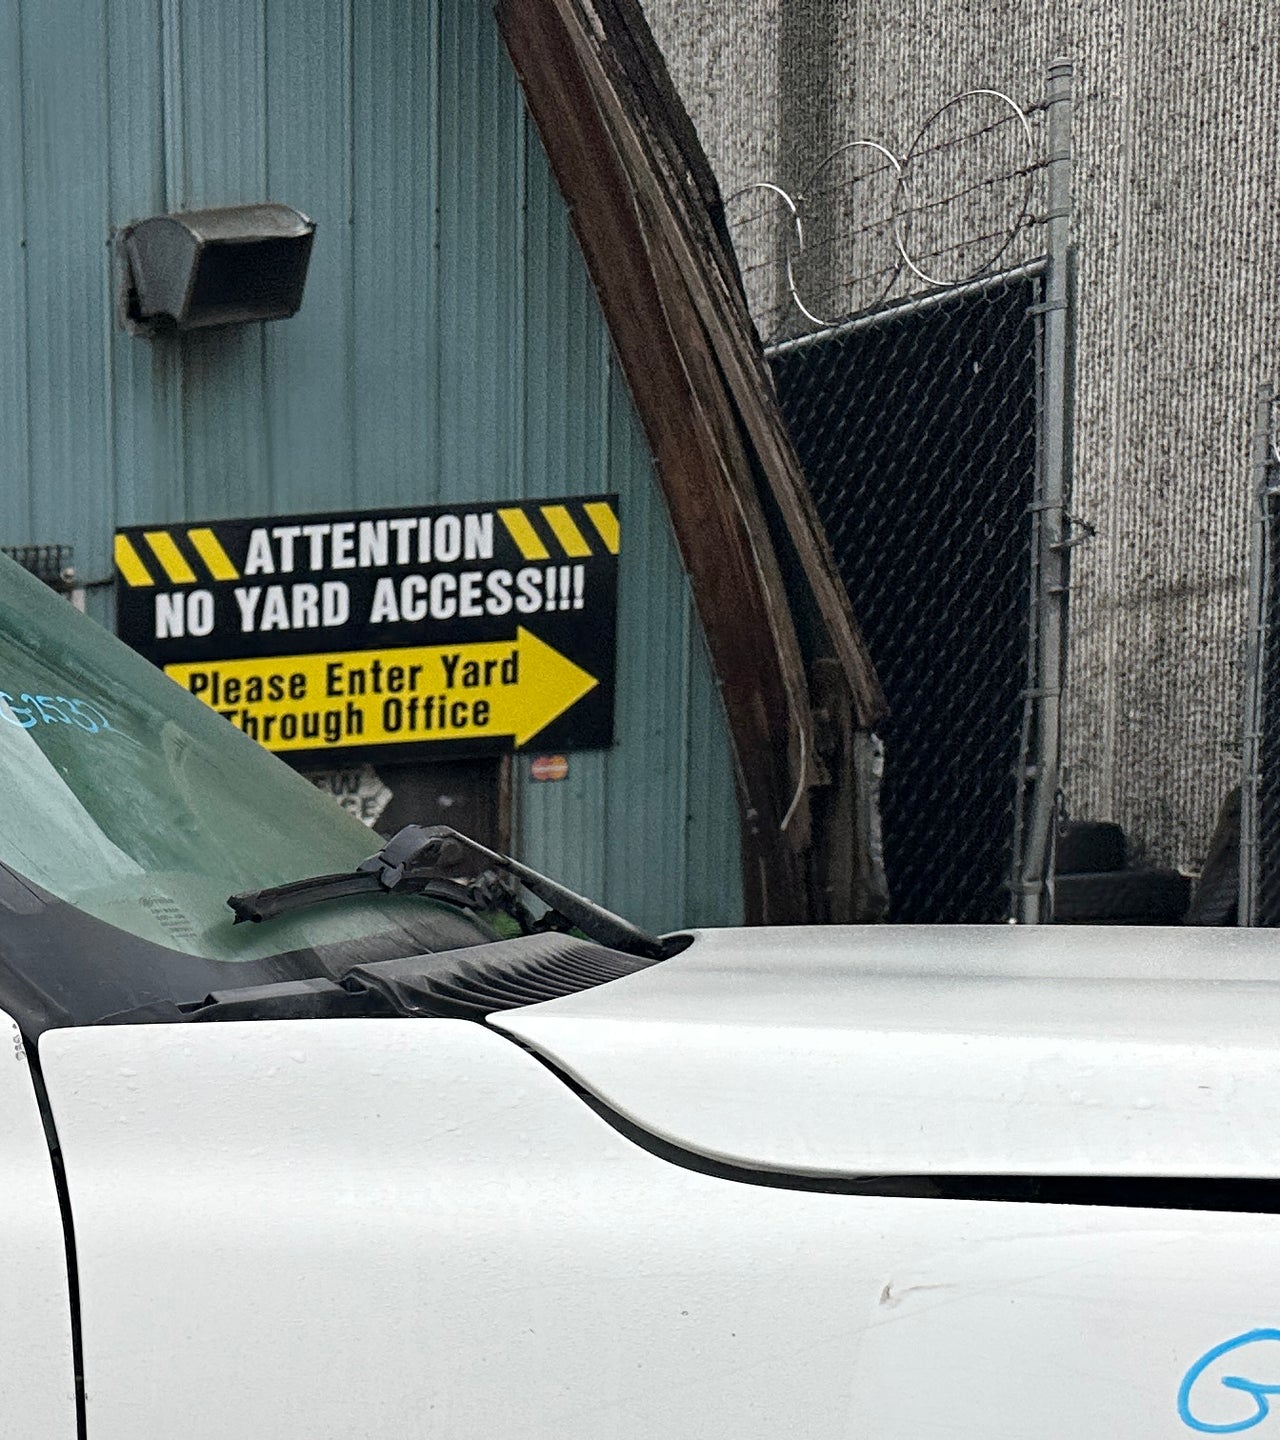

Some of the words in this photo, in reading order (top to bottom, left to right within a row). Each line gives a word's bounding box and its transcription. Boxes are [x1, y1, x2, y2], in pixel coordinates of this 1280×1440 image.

[243, 512, 495, 576] ATTENTION
[155, 591, 215, 639] NO
[234, 581, 350, 634] YARD
[370, 564, 586, 625] ACCESS!!!
[189, 670, 307, 706] Please
[326, 660, 423, 699] Enter
[440, 650, 520, 690] Yard
[382, 696, 491, 734] Office
